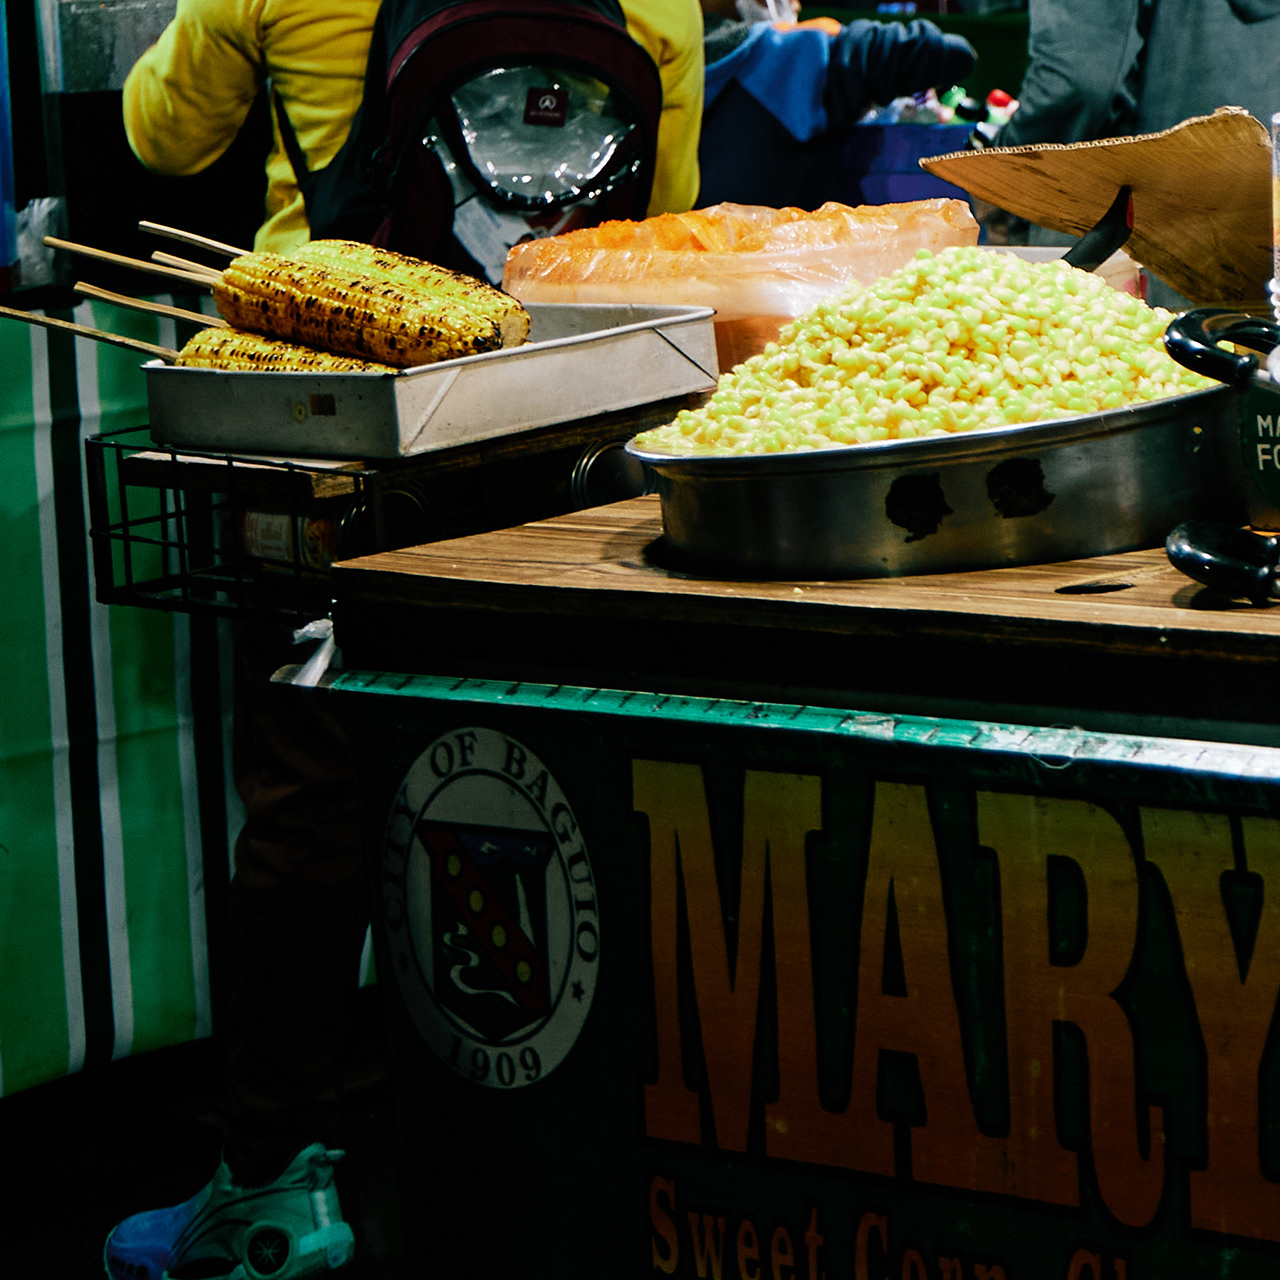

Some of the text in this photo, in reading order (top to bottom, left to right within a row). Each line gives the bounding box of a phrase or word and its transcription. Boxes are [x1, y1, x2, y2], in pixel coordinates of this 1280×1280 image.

[429, 730, 478, 779] OF
[502, 736, 599, 964] BAGUIO
[447, 1033, 542, 1088] 1909
[649, 1176, 826, 1280] Sweet
